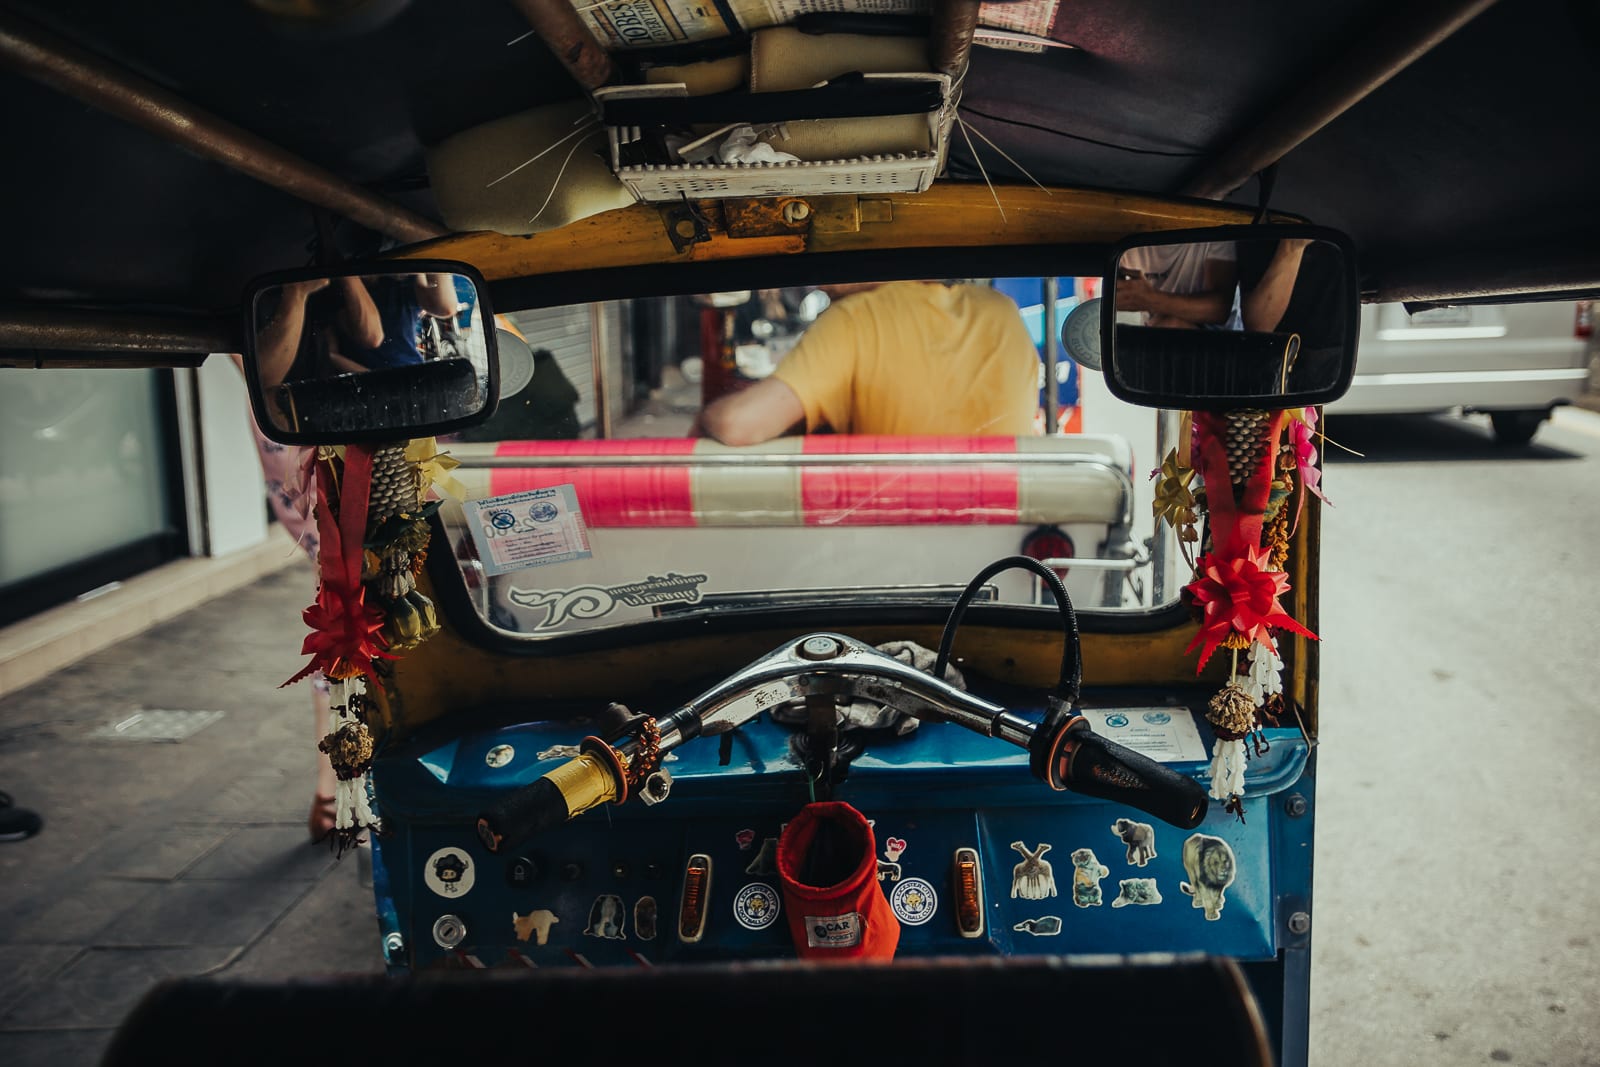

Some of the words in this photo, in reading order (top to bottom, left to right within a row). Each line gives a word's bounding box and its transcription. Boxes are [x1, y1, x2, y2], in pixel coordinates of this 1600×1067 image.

[606, 0, 643, 28] BES
[895, 882, 922, 901] LEICESTER
[895, 903, 923, 920] FOOTBALL
[826, 921, 850, 931] CAR
[827, 931, 854, 941] POCKET
